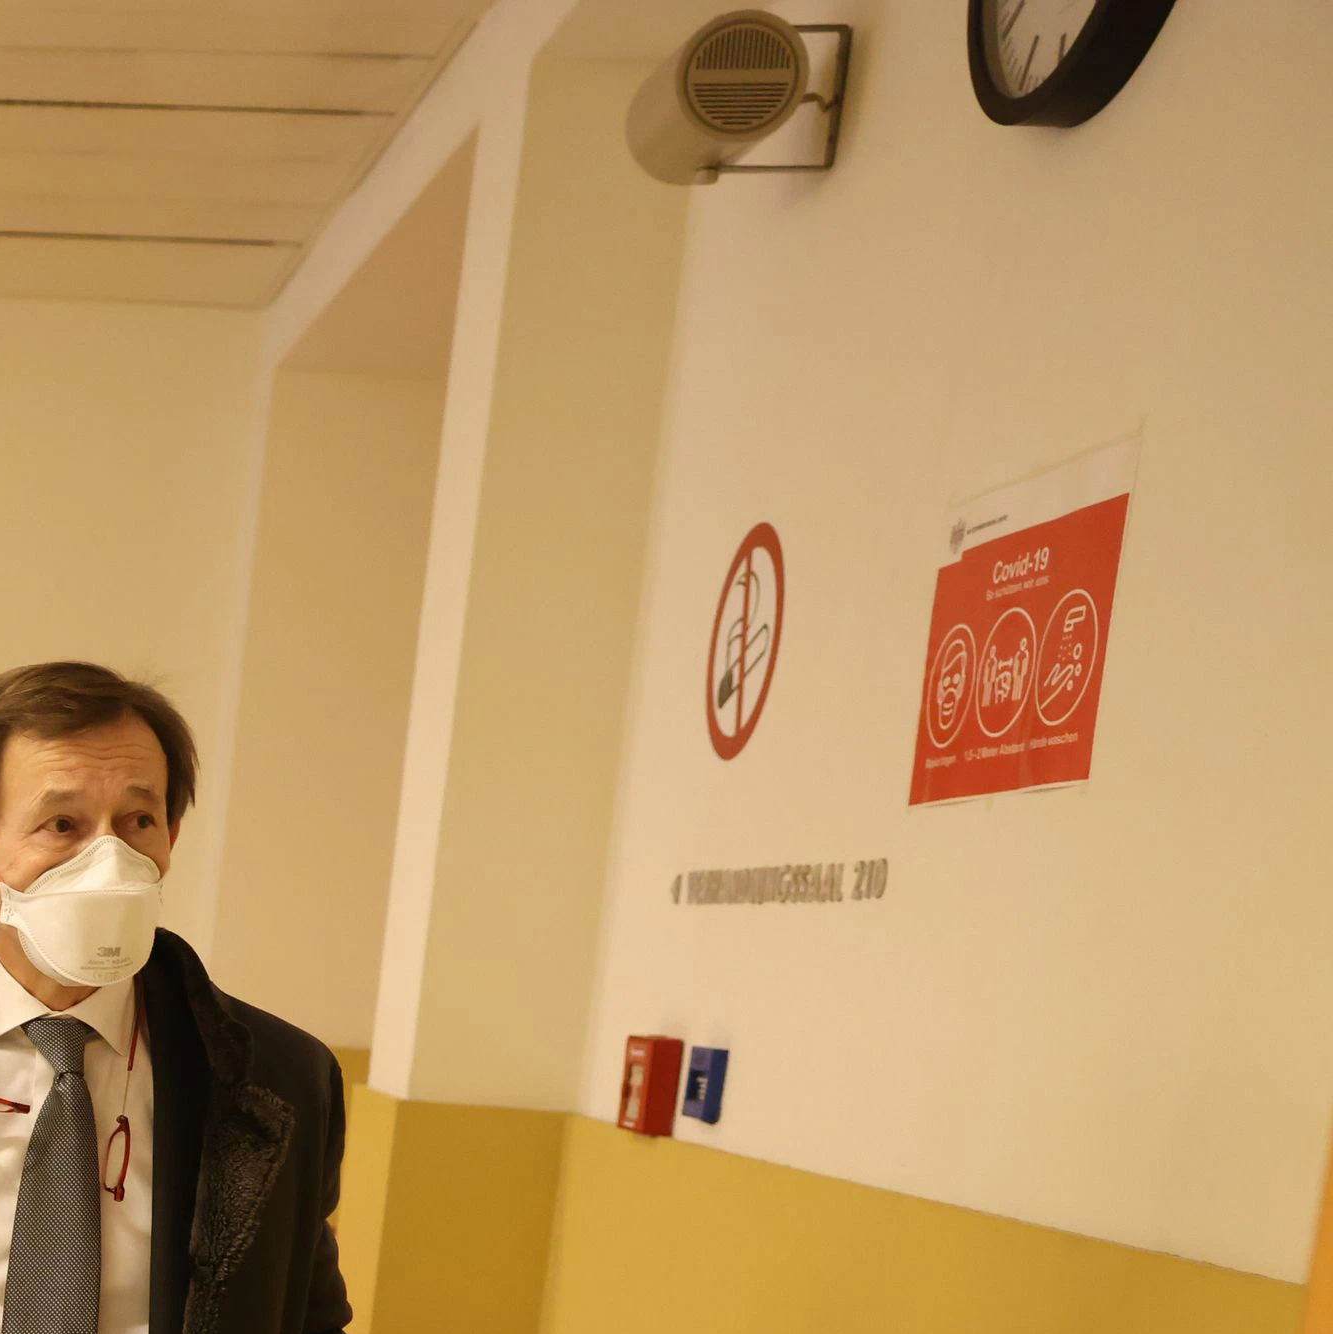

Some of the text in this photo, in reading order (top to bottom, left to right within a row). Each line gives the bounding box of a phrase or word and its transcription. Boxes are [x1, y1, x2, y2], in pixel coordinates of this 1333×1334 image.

[993, 547, 1049, 584] Covid-19
[851, 857, 889, 900] 210
[96, 946, 121, 957] 3M
